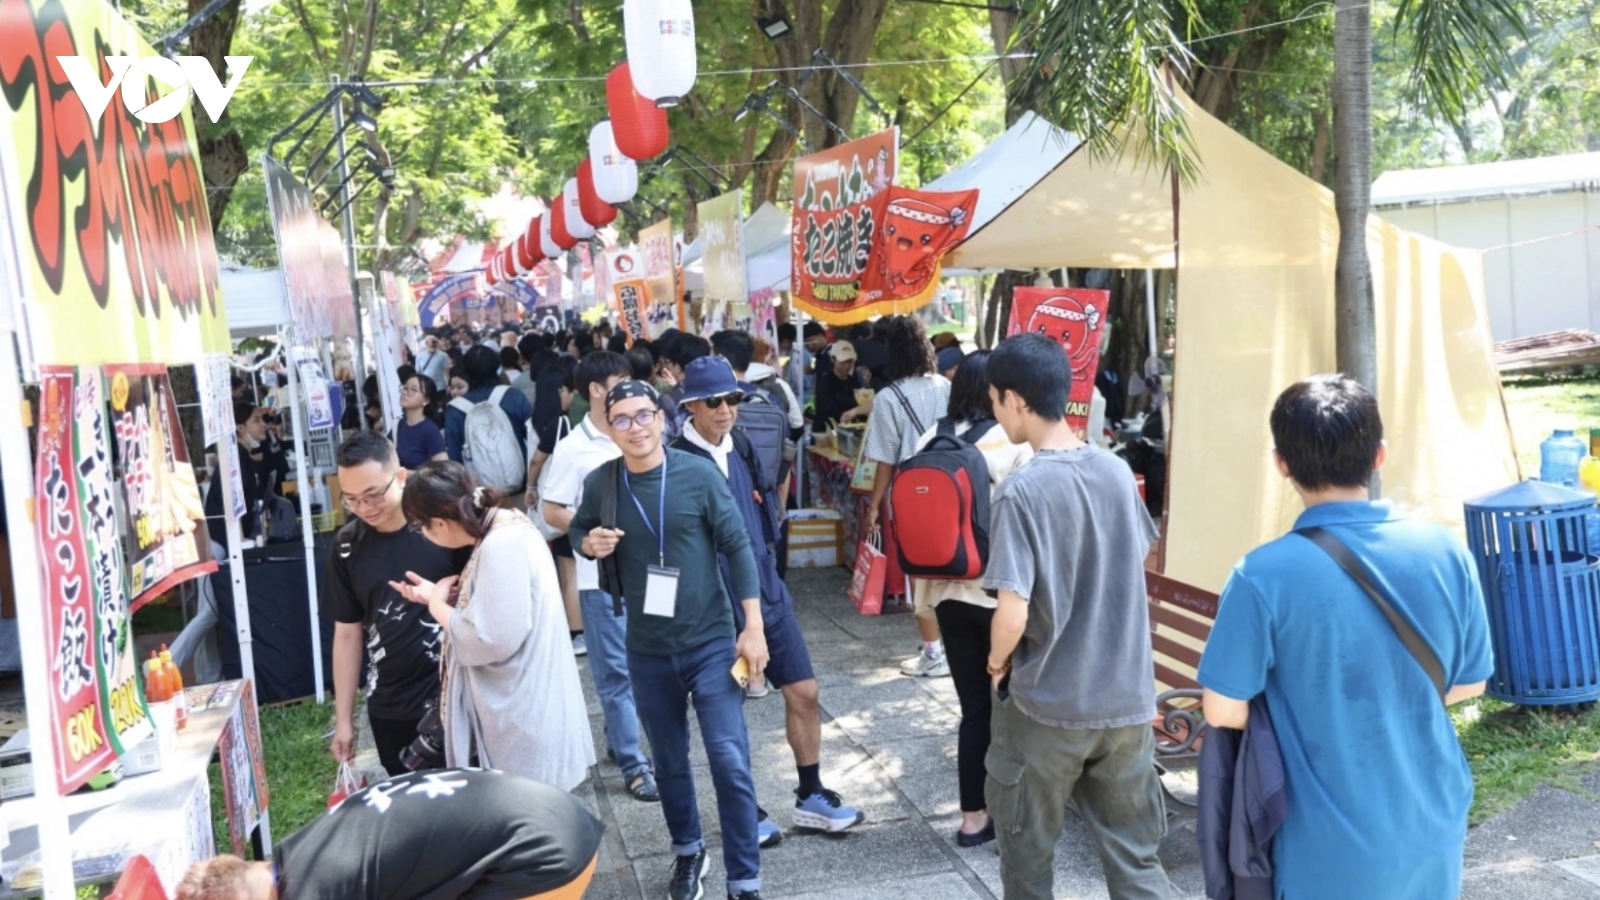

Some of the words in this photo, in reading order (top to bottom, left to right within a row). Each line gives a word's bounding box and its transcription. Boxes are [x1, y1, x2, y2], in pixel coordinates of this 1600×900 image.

[803, 213, 874, 278] たこ焼き
[44, 453, 93, 700] たこ飯
[66, 701, 103, 762] 60K
[111, 676, 145, 735] 20K
